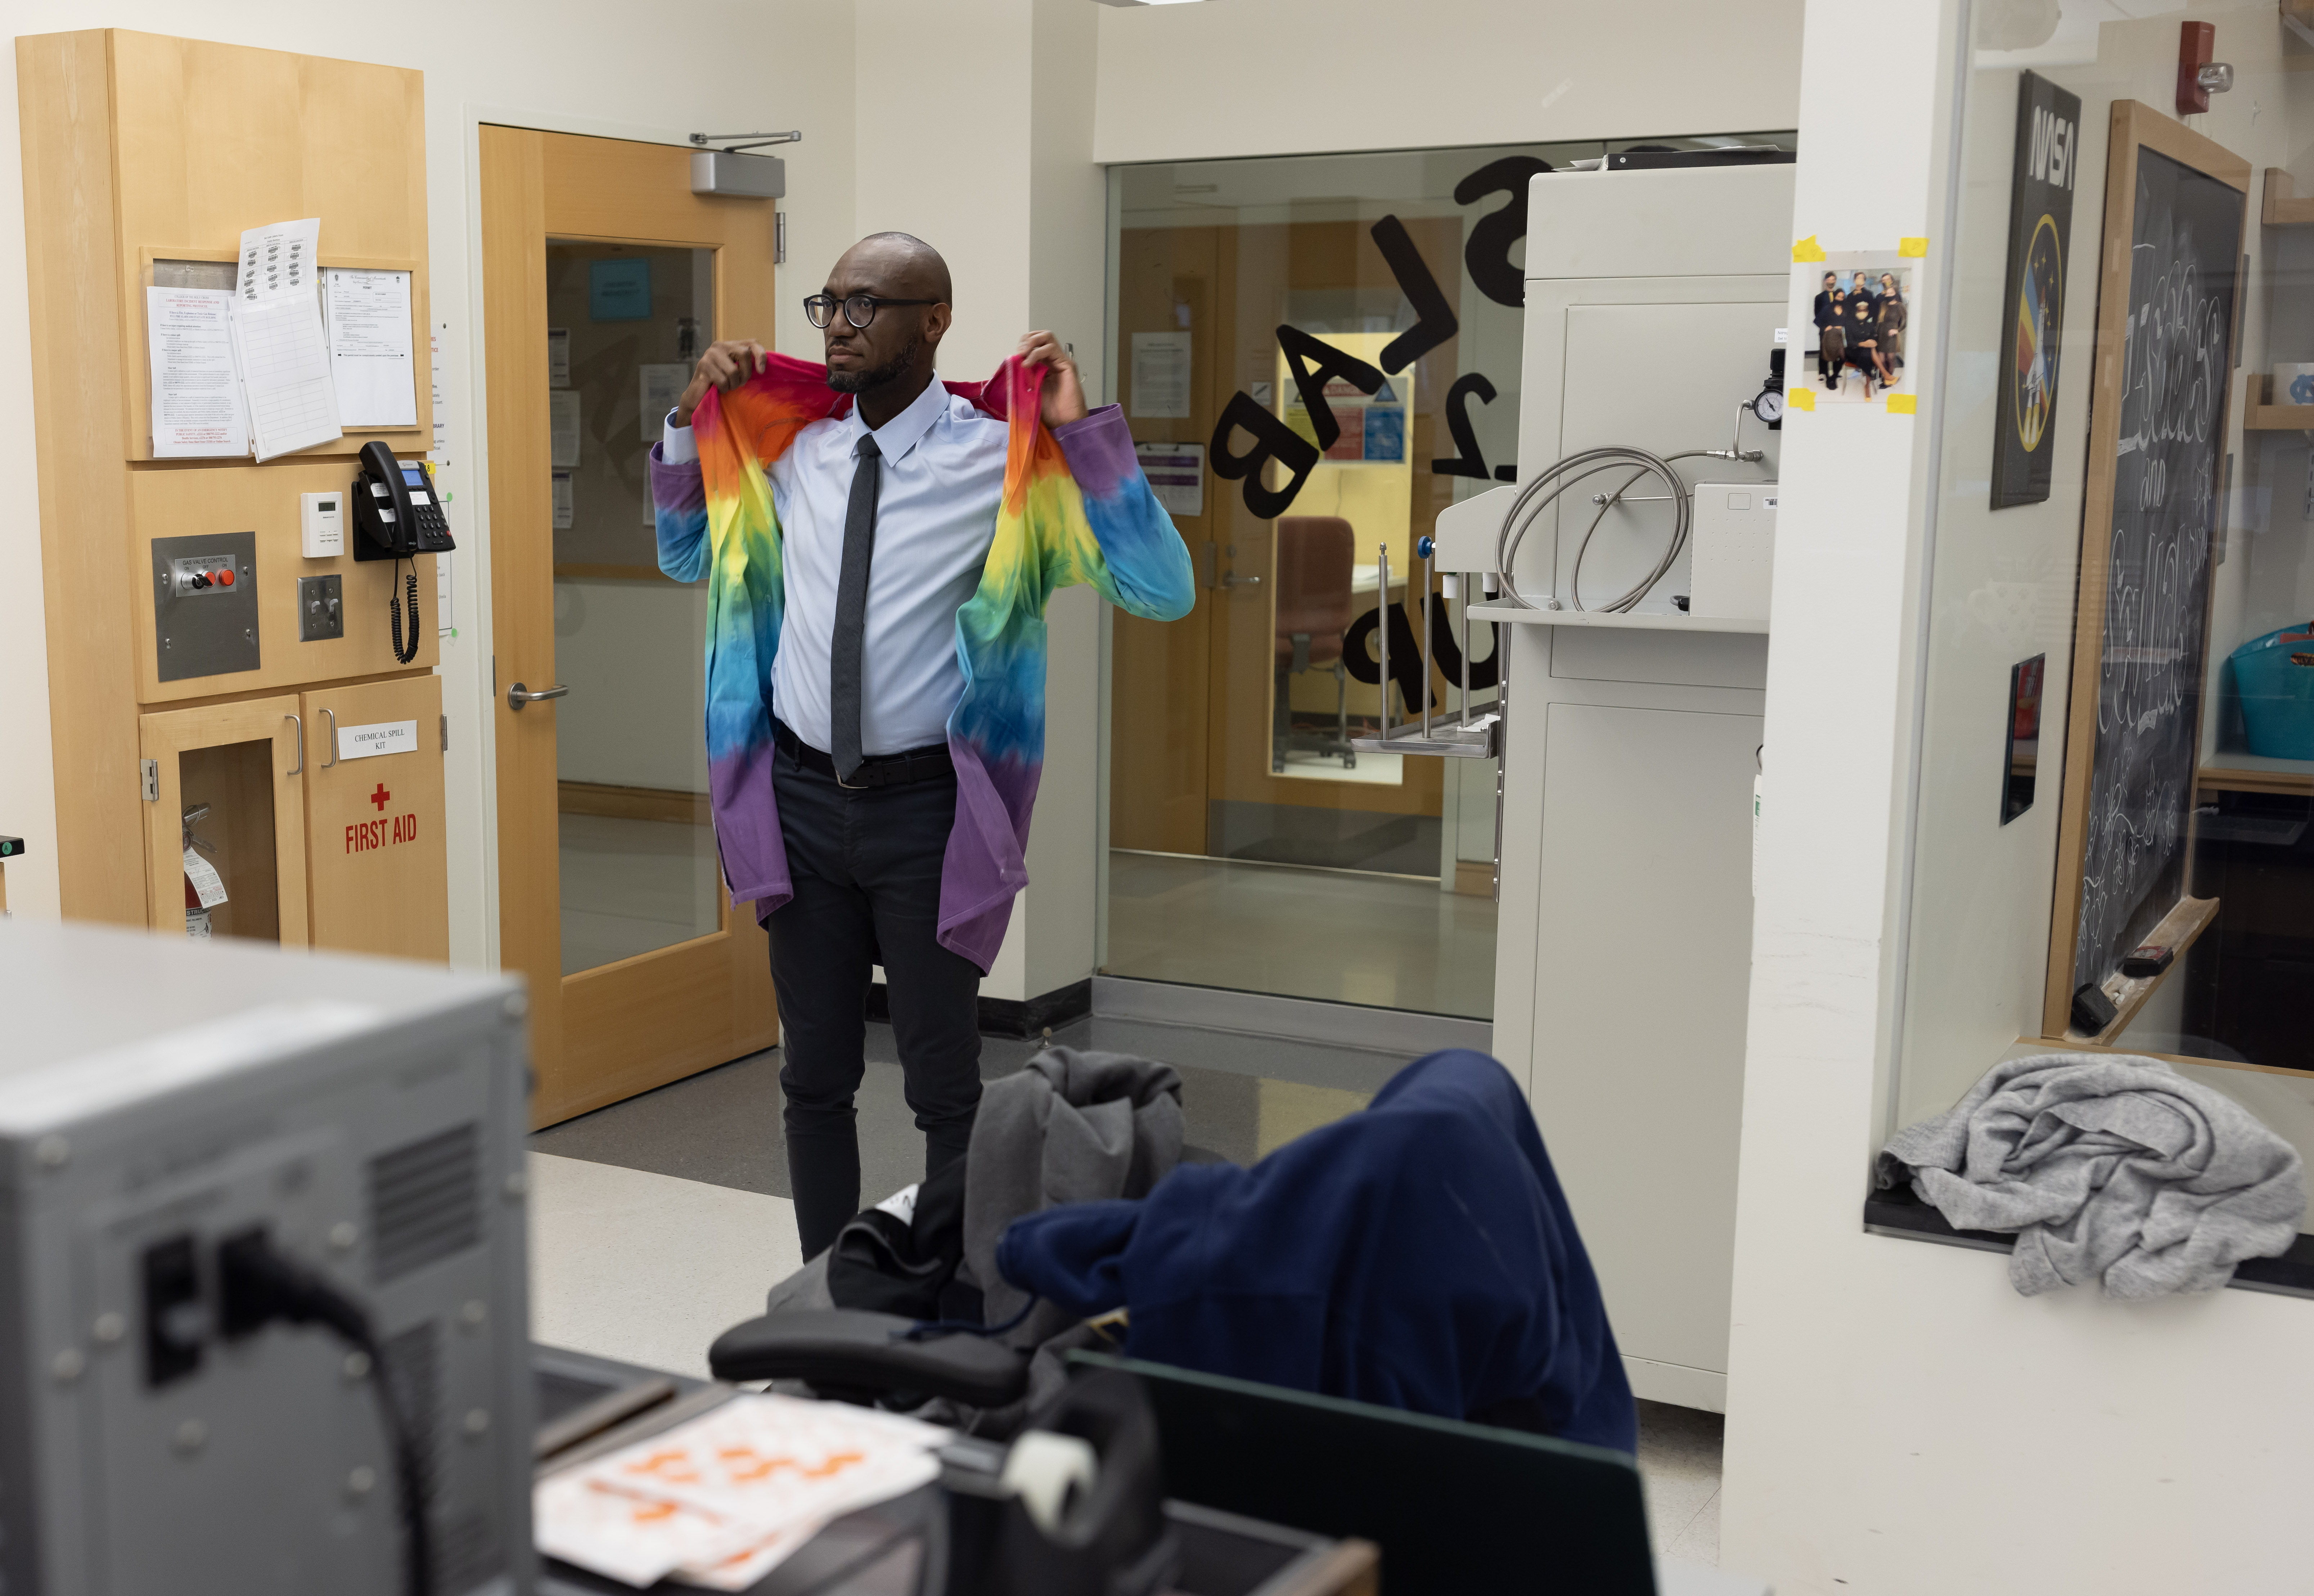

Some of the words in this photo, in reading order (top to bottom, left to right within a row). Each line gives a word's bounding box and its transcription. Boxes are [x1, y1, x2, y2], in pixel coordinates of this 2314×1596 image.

[2029, 105, 2074, 191] NASA
[355, 732, 387, 742] CHEMICAL
[388, 729, 405, 737] SPILL
[346, 819, 388, 854] FIRST
[393, 813, 417, 845] AID
